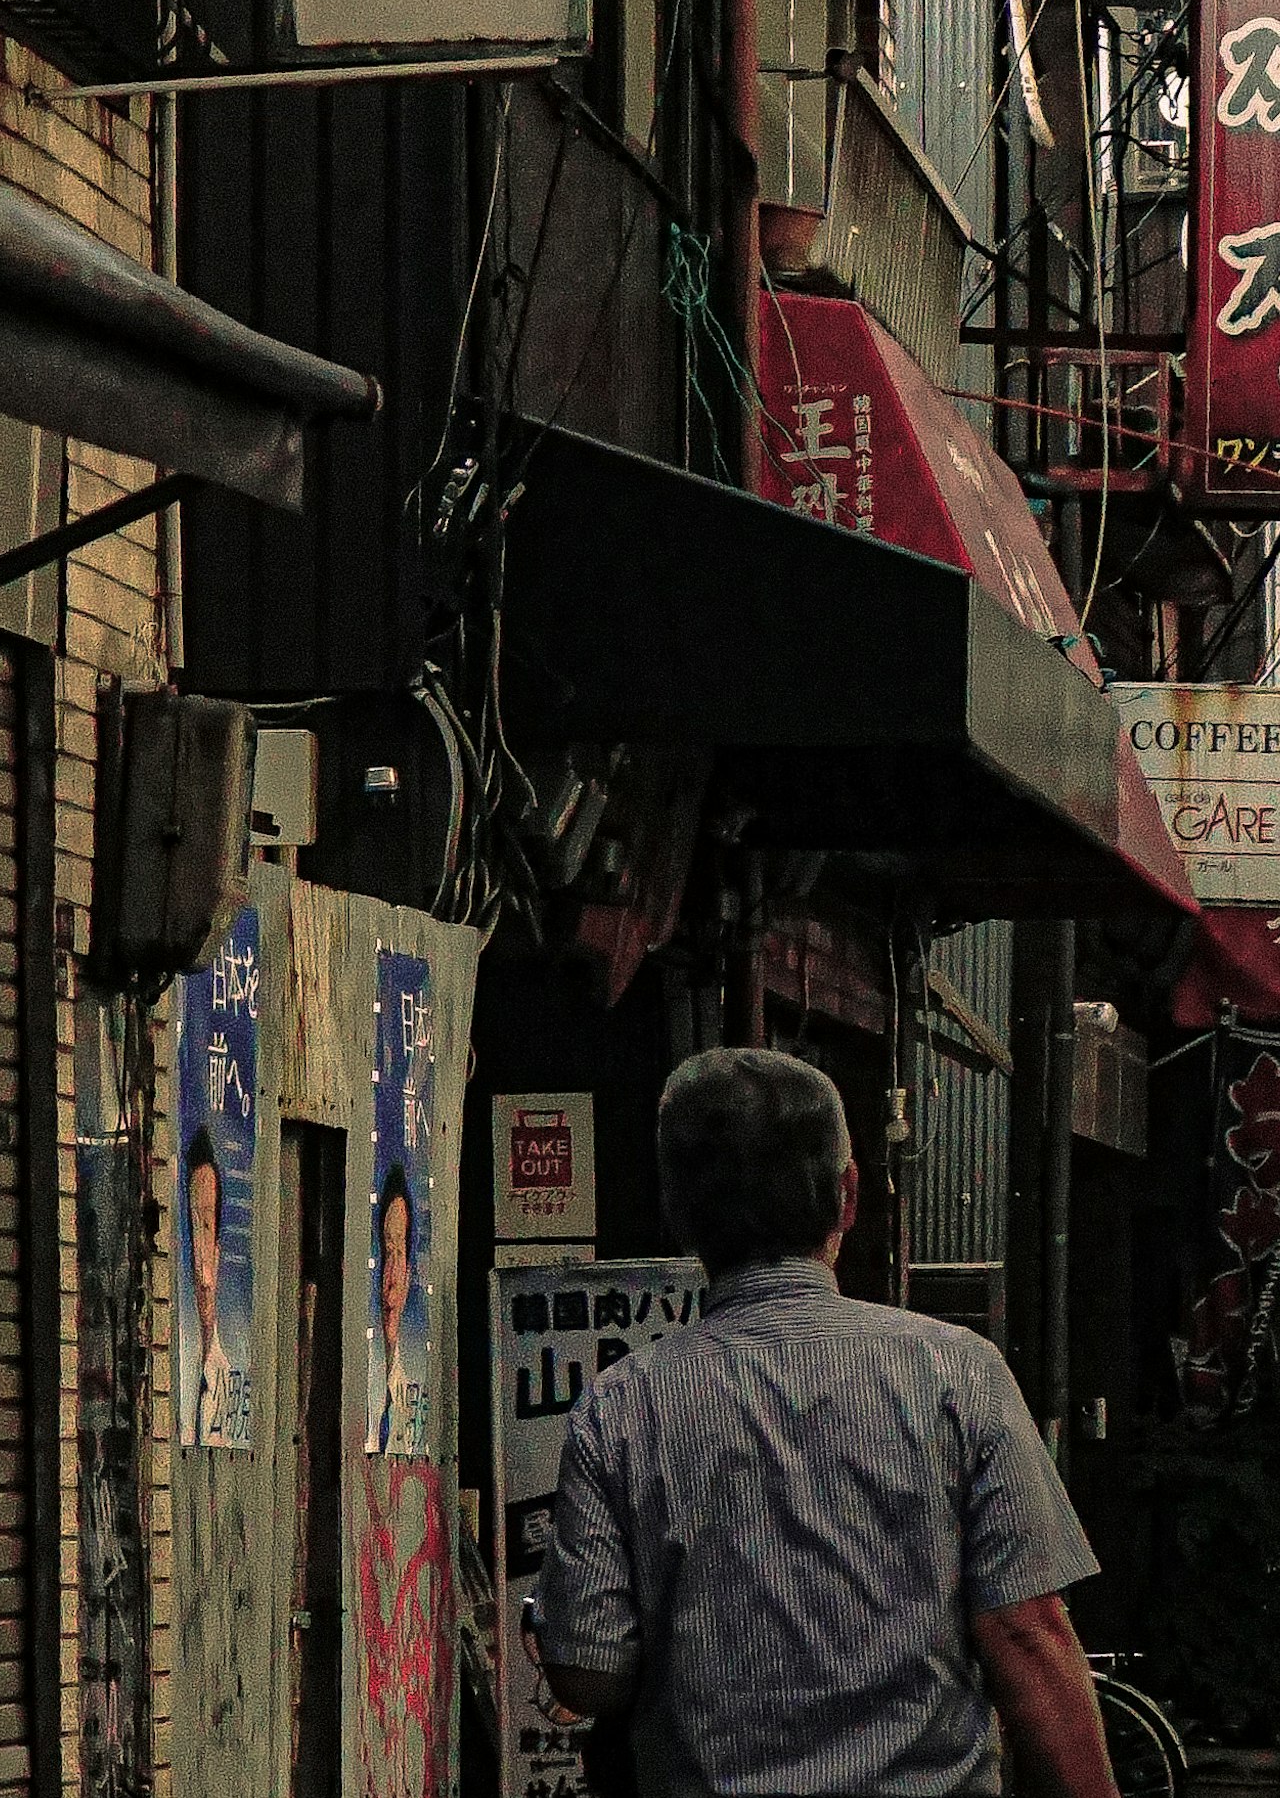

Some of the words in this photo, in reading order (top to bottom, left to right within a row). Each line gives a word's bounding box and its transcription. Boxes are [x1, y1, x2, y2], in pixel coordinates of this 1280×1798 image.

[1173, 793, 1277, 844] GARE
[514, 1139, 570, 1157] TAKE
[520, 1159, 562, 1177] OUT
